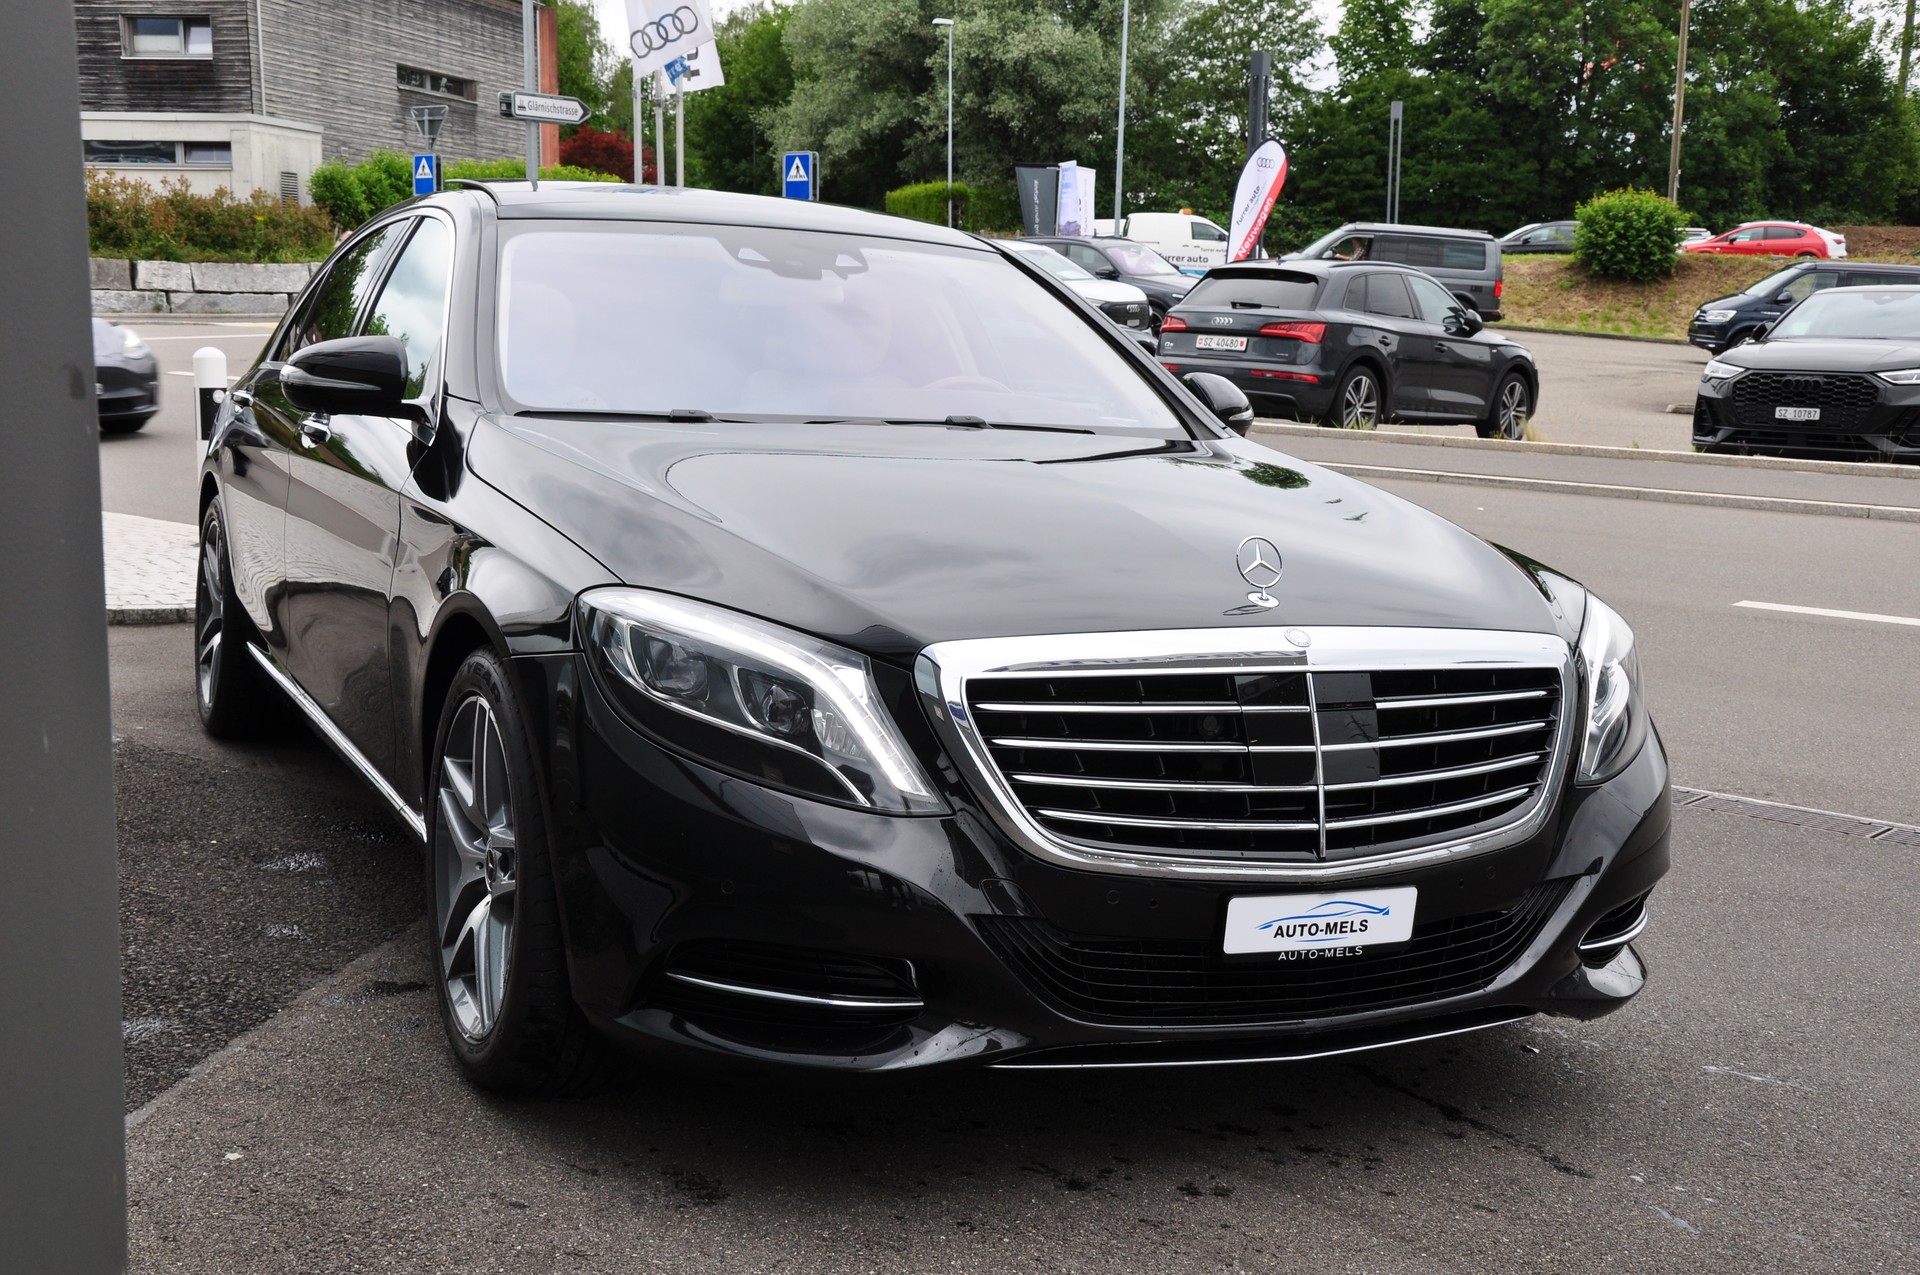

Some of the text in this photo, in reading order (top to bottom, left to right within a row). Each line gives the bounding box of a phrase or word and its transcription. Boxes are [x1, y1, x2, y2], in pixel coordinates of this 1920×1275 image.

[528, 100, 578, 116] Glärnischstrasse
[1236, 204, 1251, 226] furrer
[1249, 186, 1261, 206] auto
[1237, 197, 1273, 257] Neuwagen
[1187, 255, 1209, 263] auto
[1203, 338, 1239, 349] SZ 40480
[1778, 409, 1817, 419] SZ 10787
[1273, 919, 1369, 939] AUTO-MELS
[1278, 945, 1363, 961] AUTO-MELS
